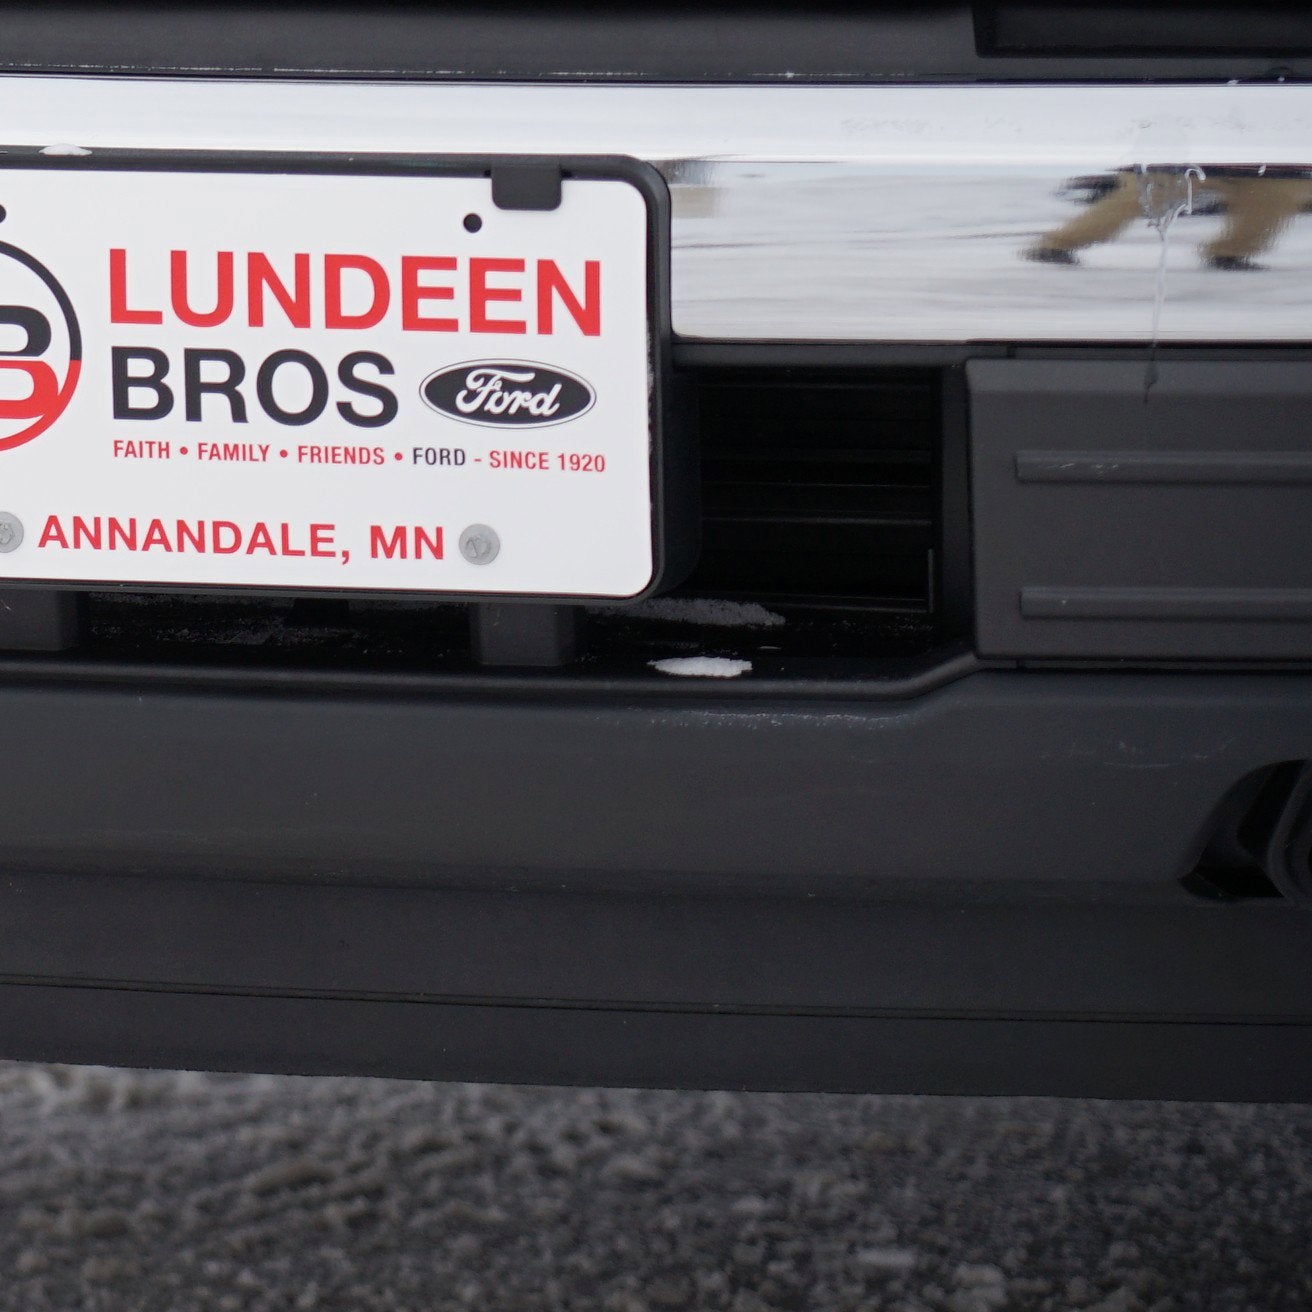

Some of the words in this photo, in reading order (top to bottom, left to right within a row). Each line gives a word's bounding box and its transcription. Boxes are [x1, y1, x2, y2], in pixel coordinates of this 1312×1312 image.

[109, 248, 601, 337] LUNDEEN
[111, 345, 399, 429] BROS
[455, 368, 563, 417] Ford
[113, 439, 170, 459] FAITH
[197, 442, 270, 462] FAMILY
[297, 445, 385, 466] FRIENDS
[412, 447, 466, 466] FORD
[489, 450, 549, 470] SINCE
[558, 453, 606, 473] 1920
[37, 514, 350, 565] ANNANDALE,
[370, 525, 444, 560] MN
